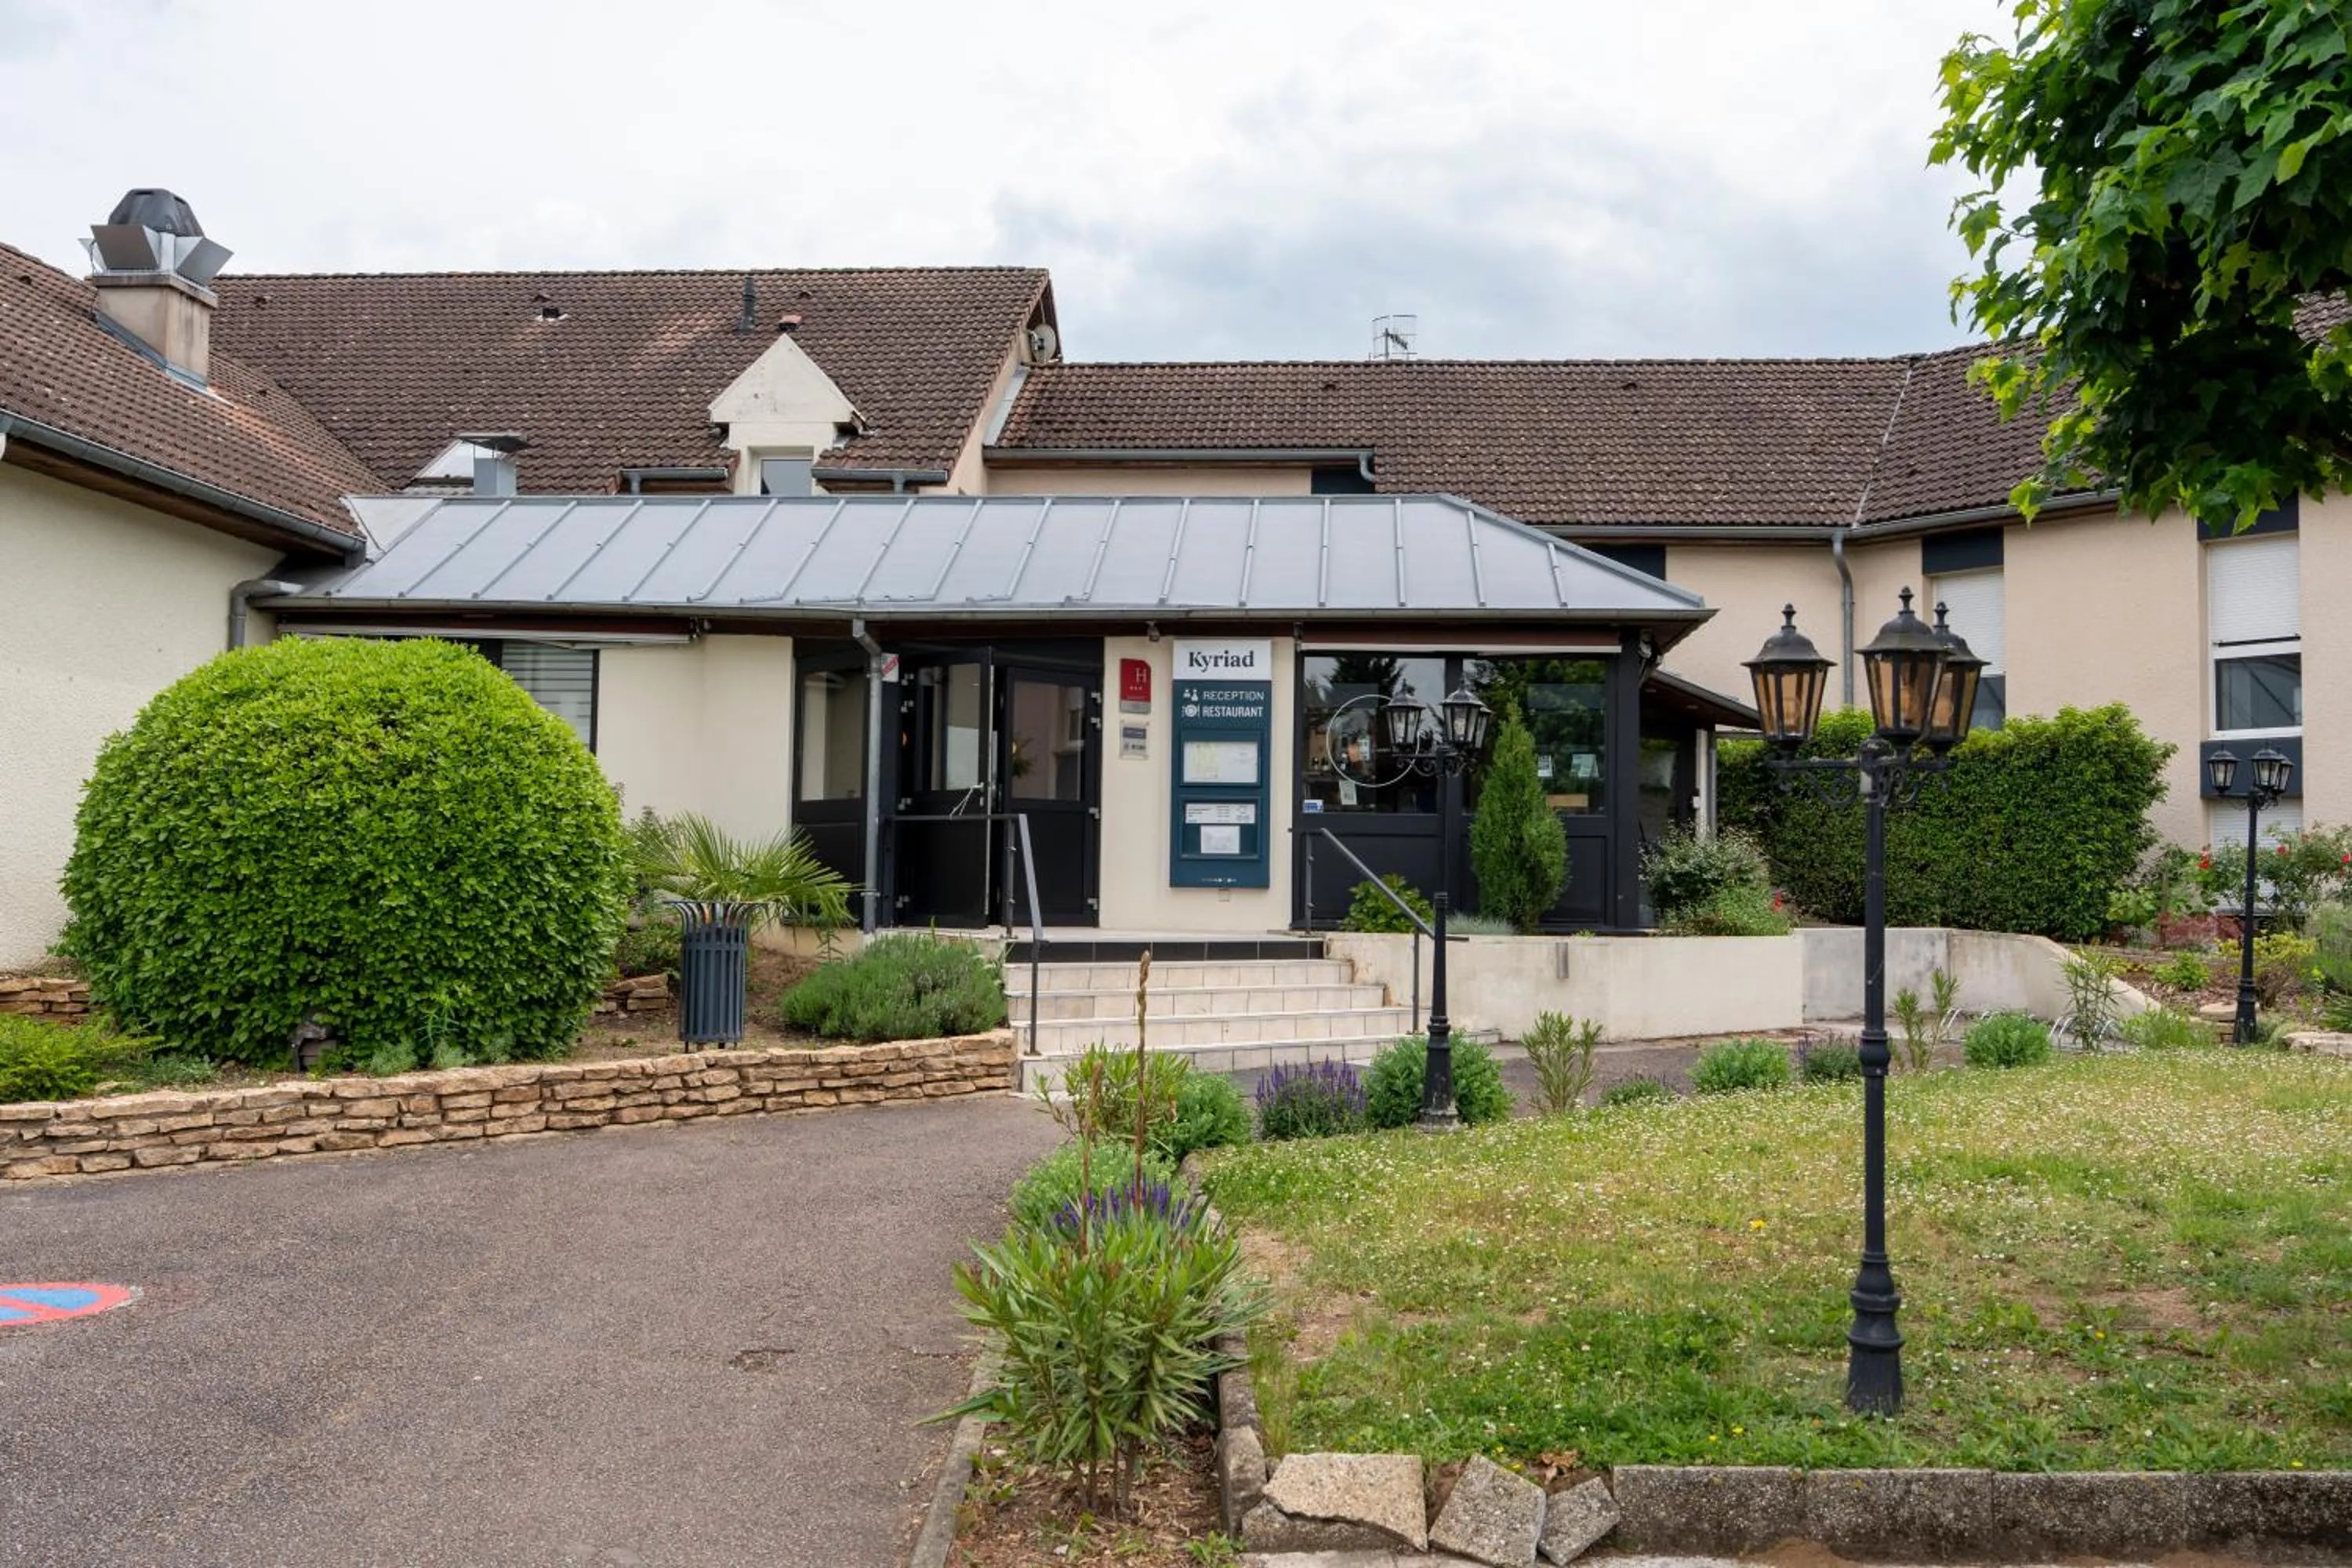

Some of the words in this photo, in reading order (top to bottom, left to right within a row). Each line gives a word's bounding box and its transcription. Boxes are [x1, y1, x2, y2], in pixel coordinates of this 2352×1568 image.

[1189, 650, 1254, 673] Kyriad
[1135, 667, 1147, 683] H
[1203, 691, 1265, 701] RECEPTION
[1202, 706, 1264, 717] RESTAURANT
